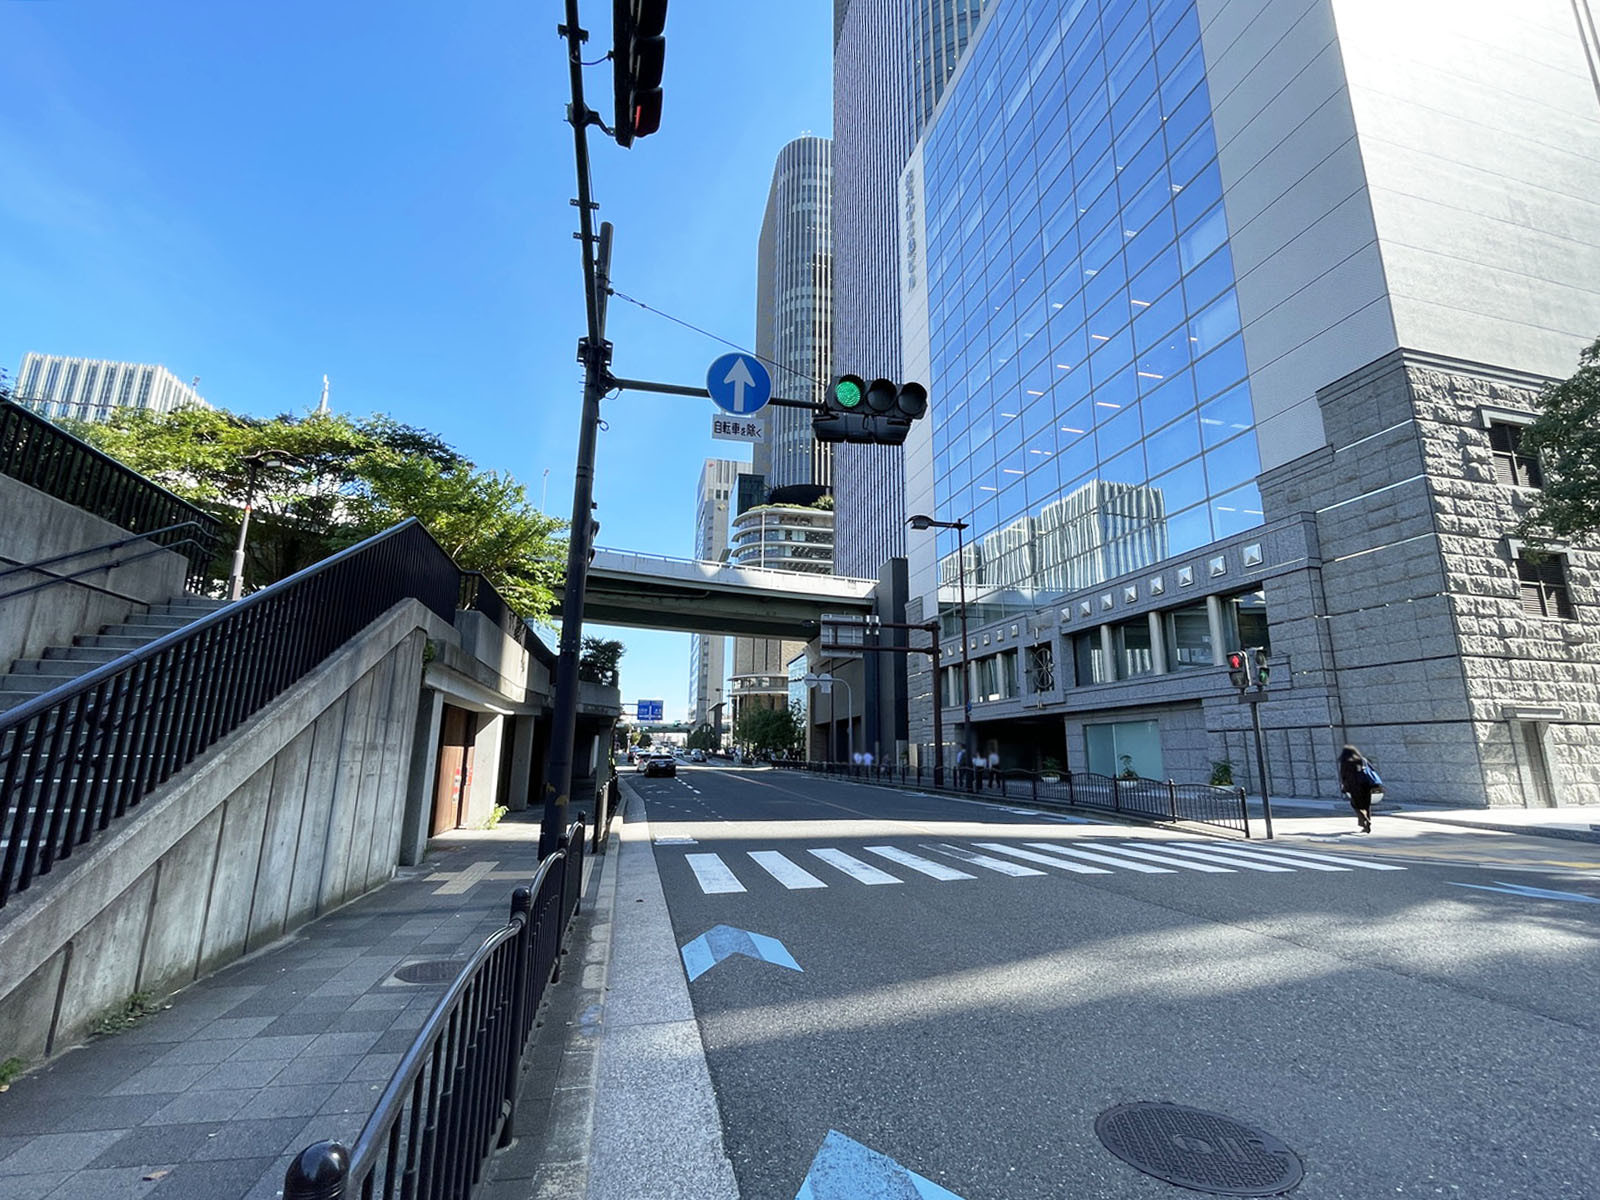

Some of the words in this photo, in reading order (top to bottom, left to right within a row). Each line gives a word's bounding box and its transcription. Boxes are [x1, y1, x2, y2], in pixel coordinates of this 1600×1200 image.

[714, 420, 762, 438] 自転車を除く
